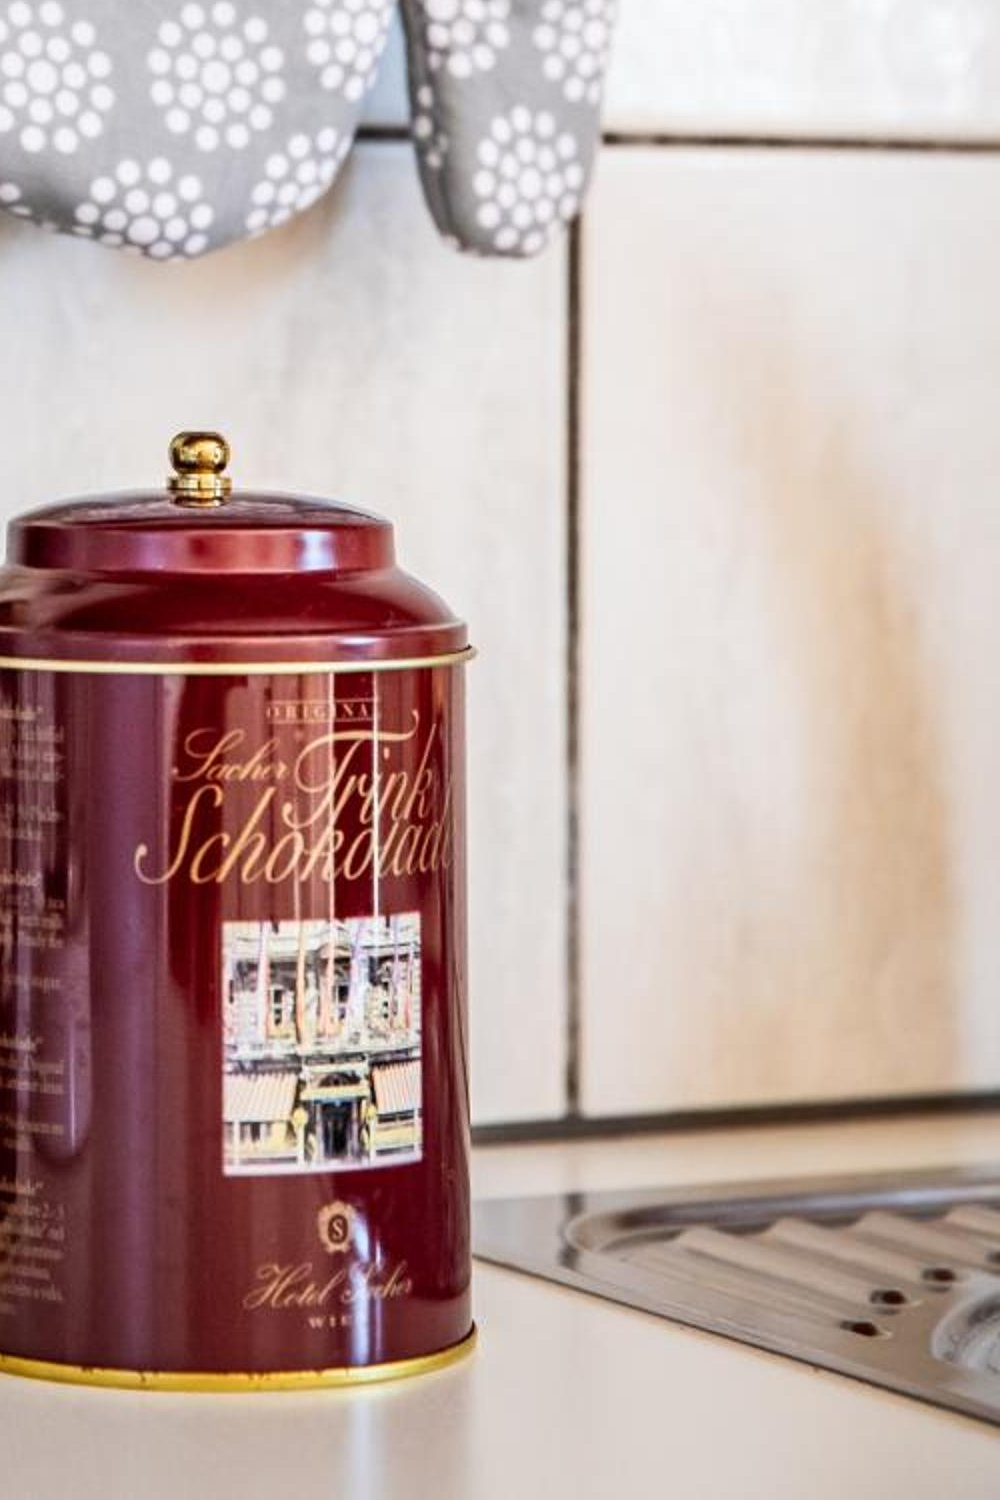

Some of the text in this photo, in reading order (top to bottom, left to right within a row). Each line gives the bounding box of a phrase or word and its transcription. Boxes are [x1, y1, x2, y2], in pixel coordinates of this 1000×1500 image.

[265, 701, 378, 719] ORIGNA
[173, 728, 290, 781] Sacher
[242, 1262, 345, 1309] Hotel
[308, 1315, 361, 1329] WIE
